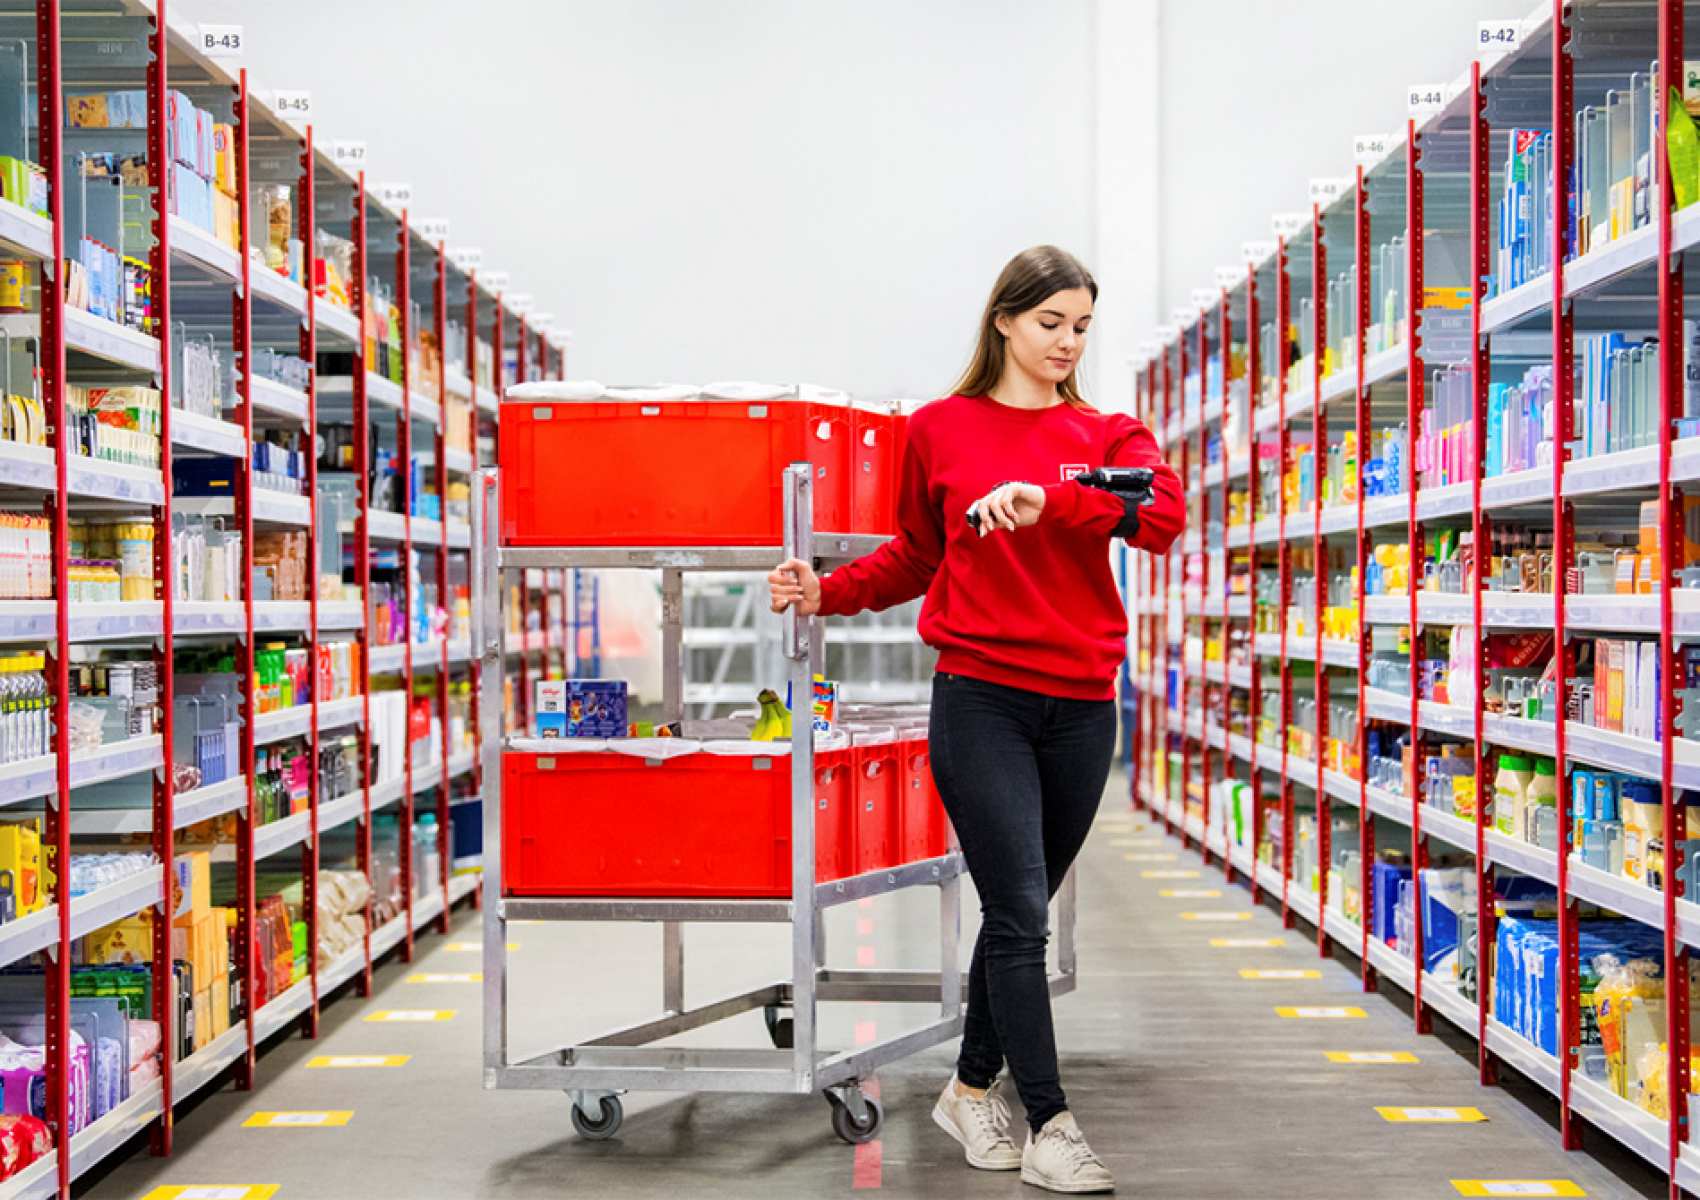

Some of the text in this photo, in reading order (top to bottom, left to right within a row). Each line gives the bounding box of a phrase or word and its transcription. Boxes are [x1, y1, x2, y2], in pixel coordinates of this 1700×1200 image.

[205, 34, 240, 48] B-43
[1480, 29, 1515, 43] B-42
[278, 97, 309, 112] B-45
[1410, 91, 1442, 105] B-44
[336, 147, 365, 159] B-47
[1355, 141, 1384, 153] B-46
